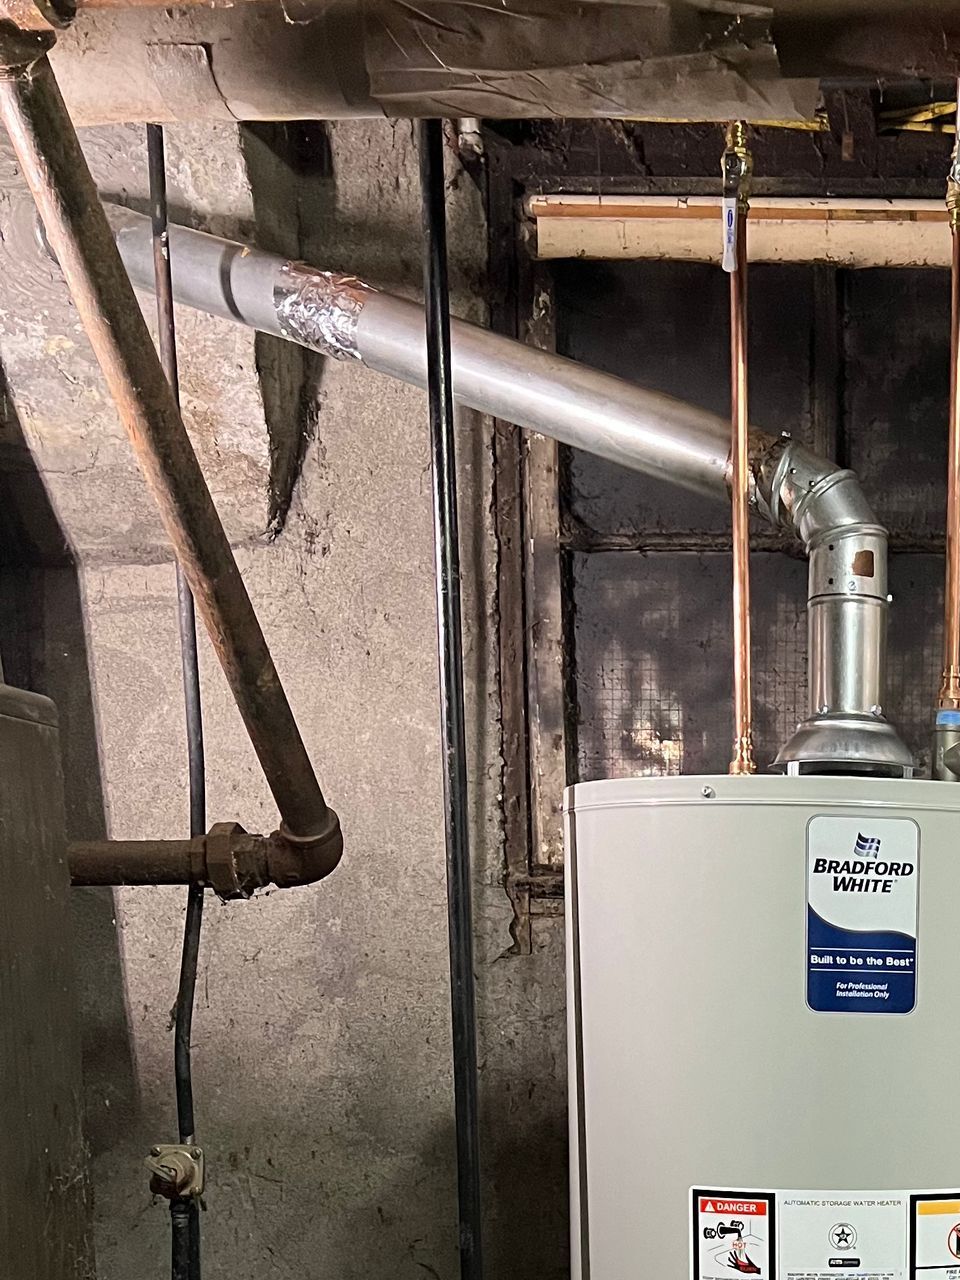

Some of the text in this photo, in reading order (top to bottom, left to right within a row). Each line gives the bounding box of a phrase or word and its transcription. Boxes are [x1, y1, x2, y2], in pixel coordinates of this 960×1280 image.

[813, 858, 914, 876] BRADFORD
[833, 876, 893, 893] WHITE
[810, 955, 833, 963] Built
[836, 956, 846, 964] to
[850, 956, 863, 965] be
[866, 957, 883, 965] the
[848, 982, 888, 990] Professional
[874, 991, 890, 999] Only
[717, 1203, 757, 1212] DANGER
